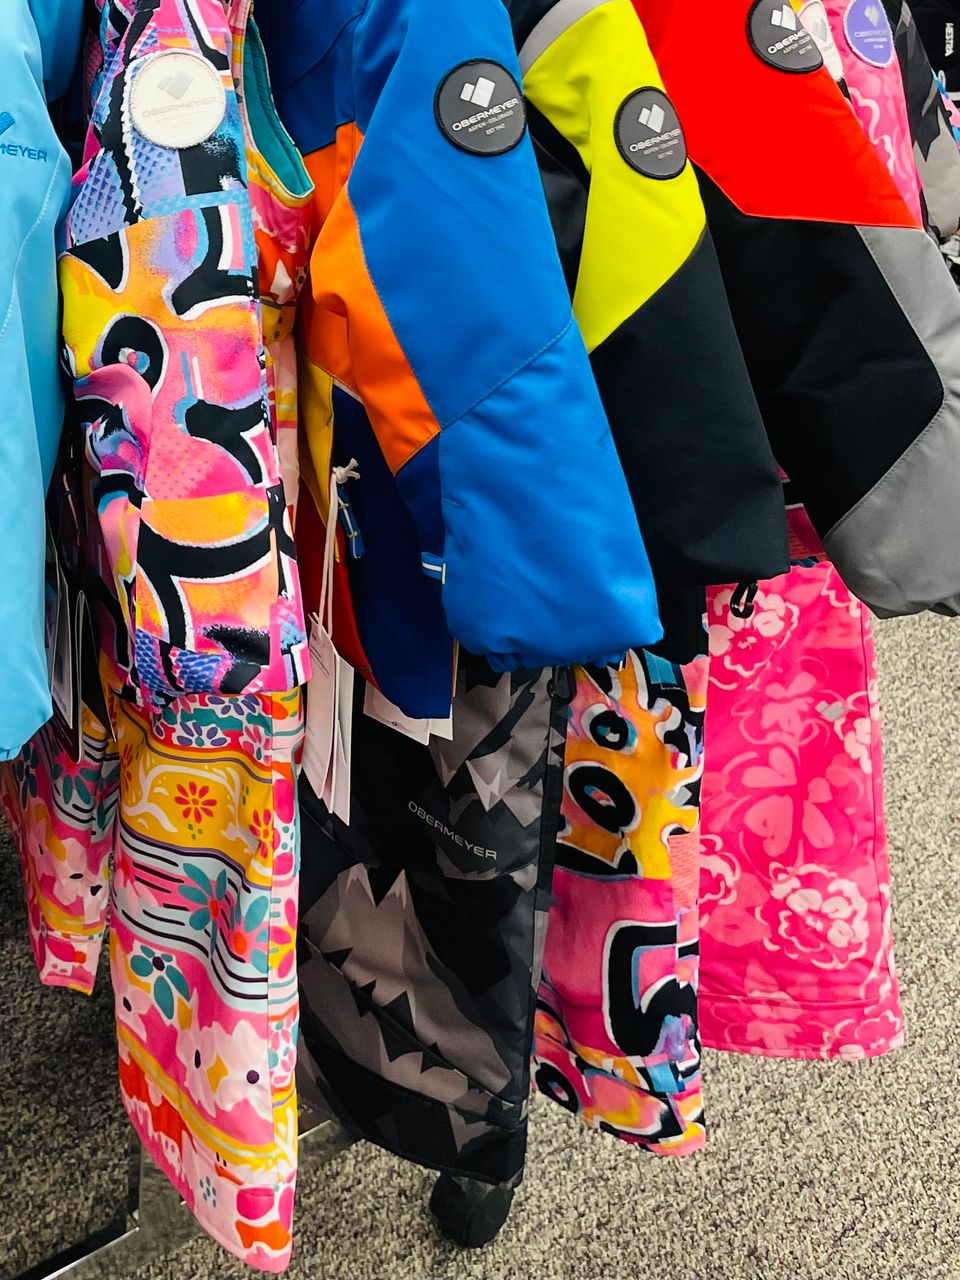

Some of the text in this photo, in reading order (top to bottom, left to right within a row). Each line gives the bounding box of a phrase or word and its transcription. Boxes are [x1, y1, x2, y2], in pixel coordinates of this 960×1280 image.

[943, 22, 954, 58] HESTRA
[452, 97, 519, 131] OBERMEYER
[408, 800, 498, 861] OBERMEYER
